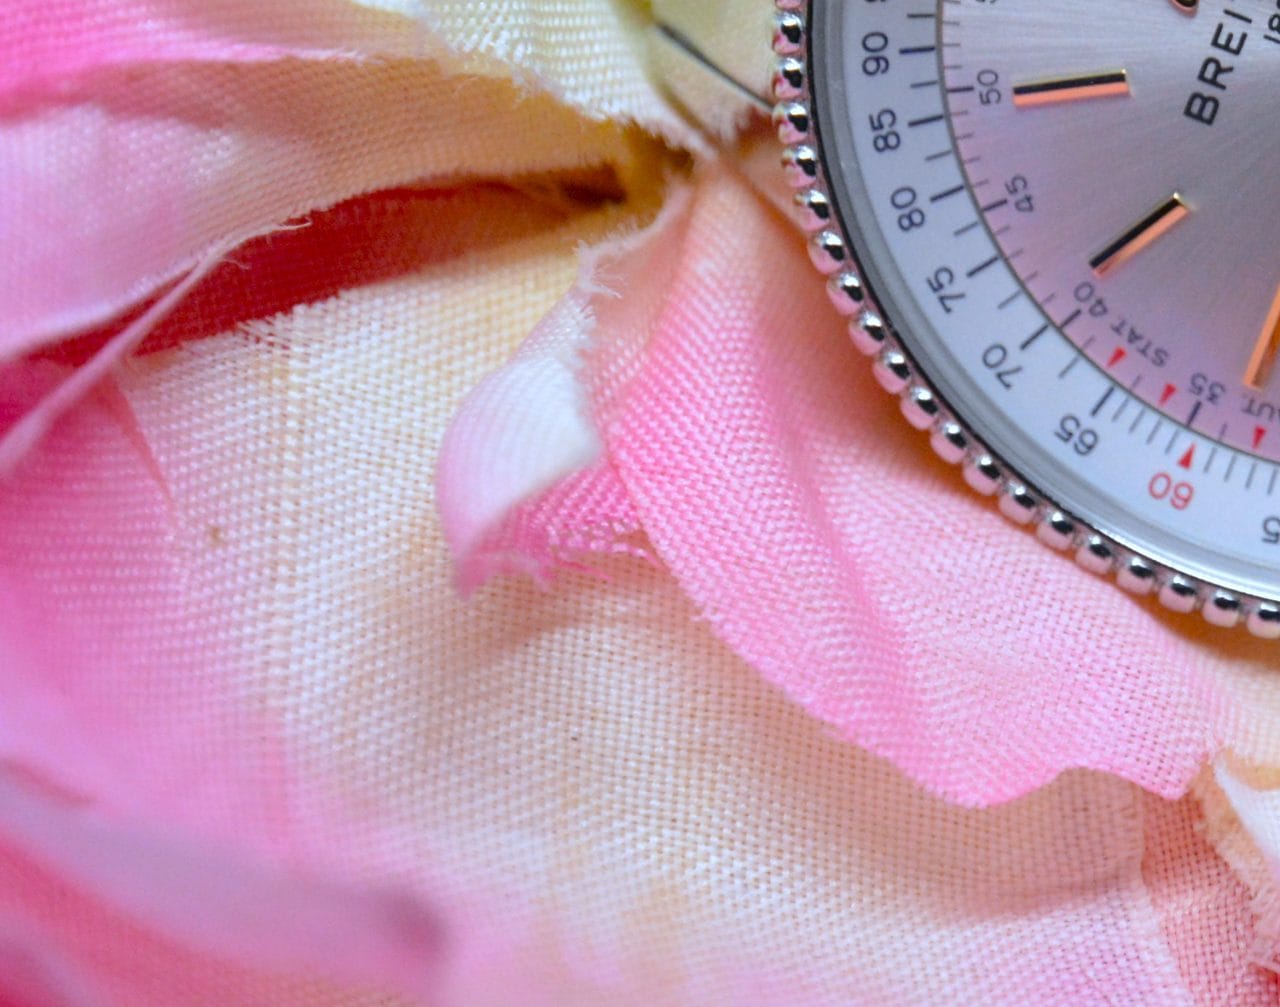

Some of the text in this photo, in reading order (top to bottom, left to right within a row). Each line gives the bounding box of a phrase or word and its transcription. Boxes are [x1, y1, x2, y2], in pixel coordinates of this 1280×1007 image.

[862, 32, 890, 76] 90
[979, 69, 1001, 105] 50
[869, 107, 901, 152] 85
[890, 186, 925, 232] 80
[1005, 174, 1034, 214] 45
[926, 265, 966, 314] 75
[1073, 282, 1109, 319] 40
[1111, 318, 1170, 367] STAT
[981, 343, 1024, 389] 70
[1190, 373, 1226, 405] 35
[1055, 414, 1100, 457] 65
[1148, 472, 1194, 510] 60
